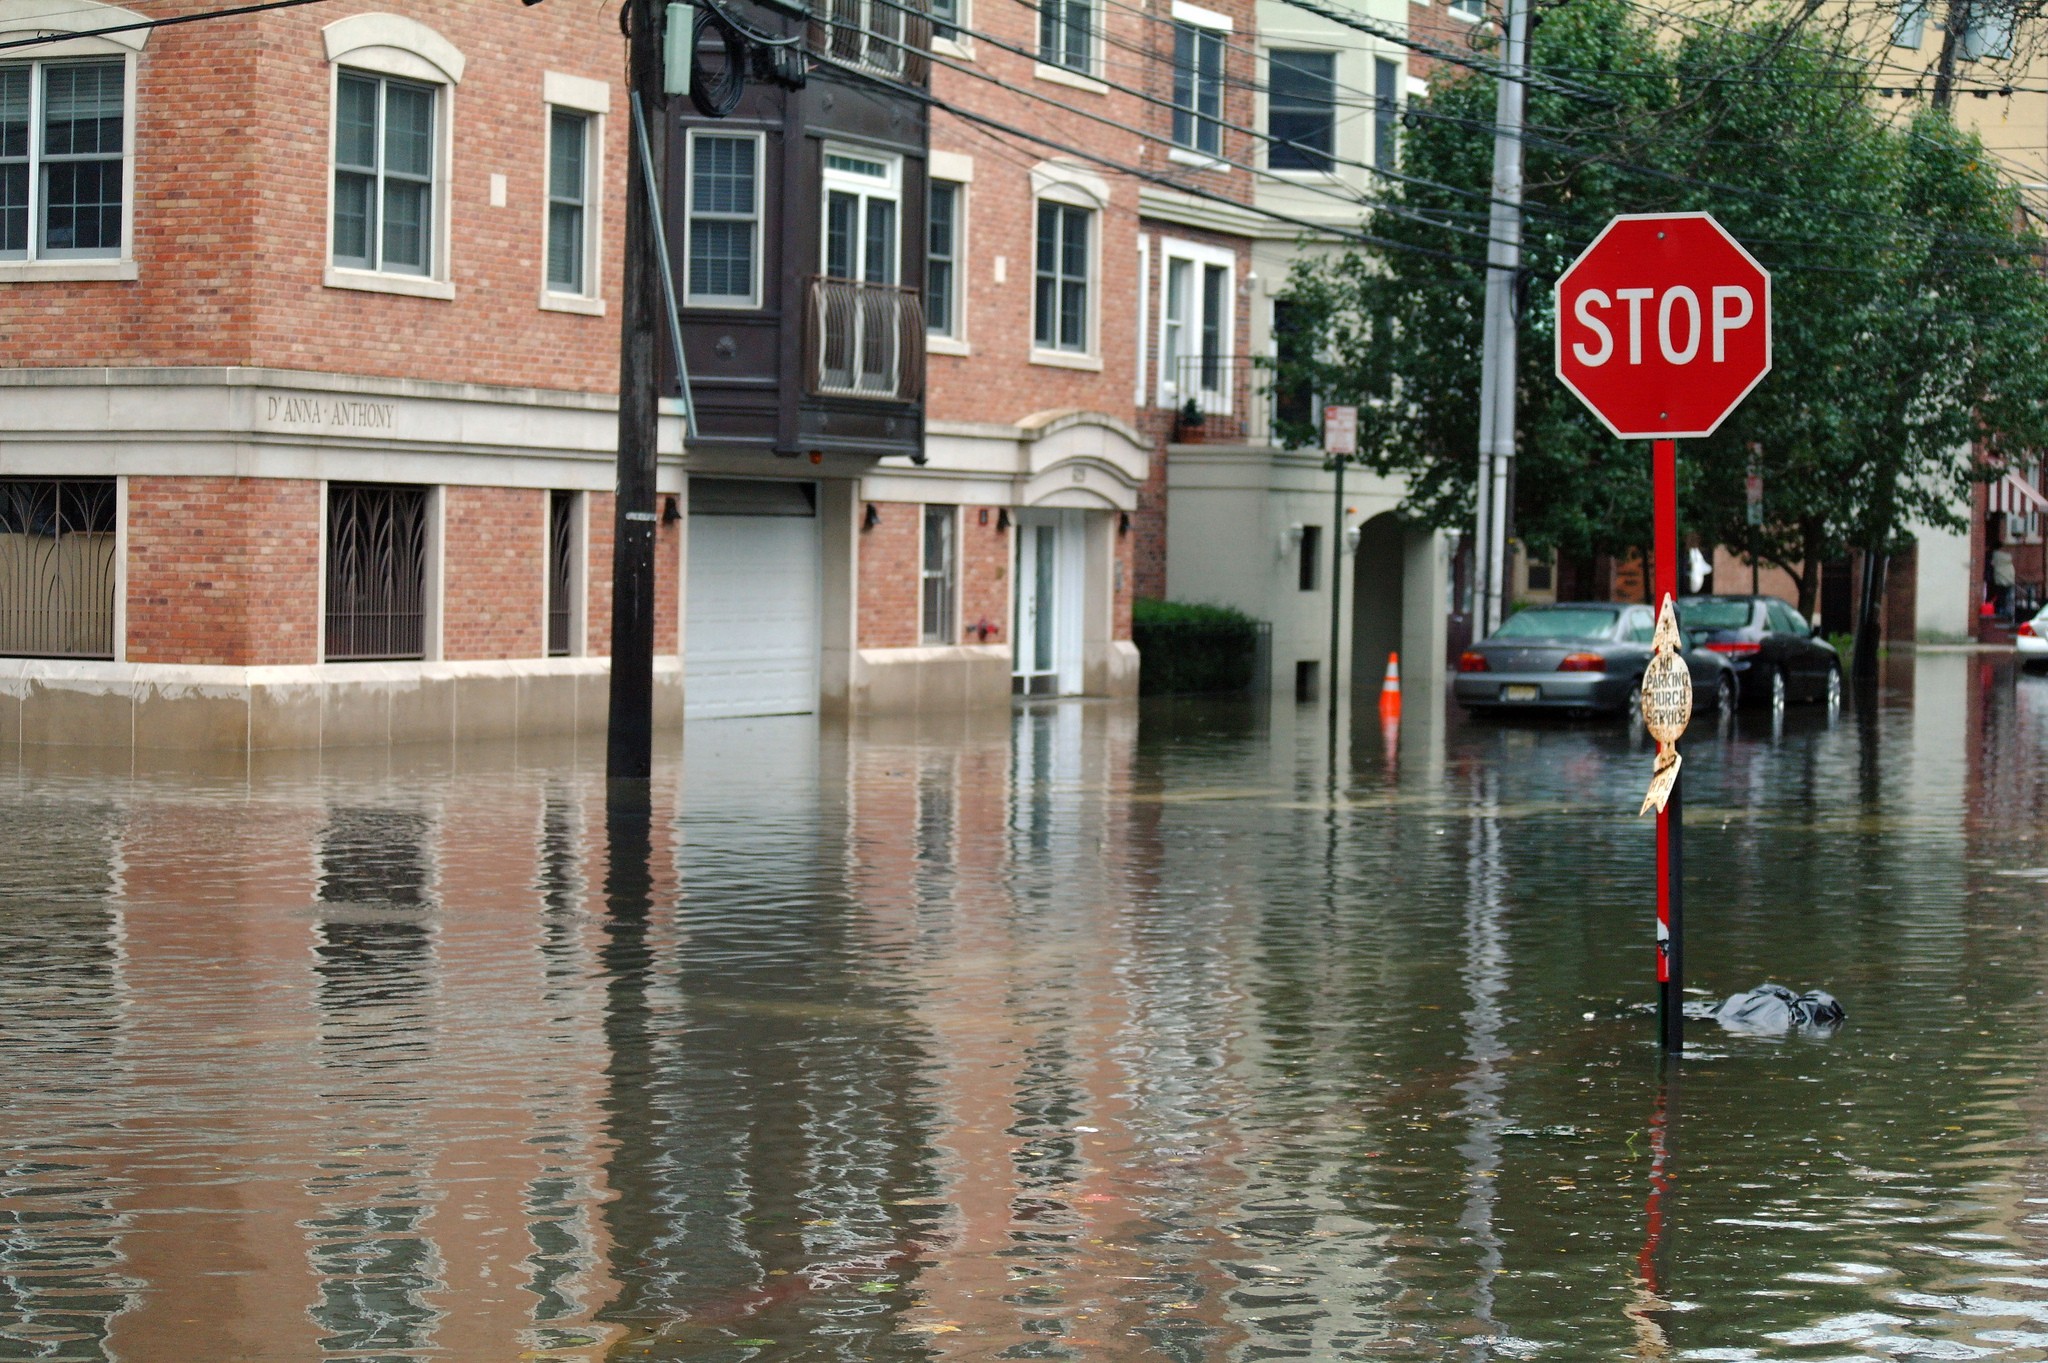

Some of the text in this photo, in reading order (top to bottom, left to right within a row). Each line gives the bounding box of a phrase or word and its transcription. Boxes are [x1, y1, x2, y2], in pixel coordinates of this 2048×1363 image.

[1572, 285, 1754, 368] STOP
[331, 402, 394, 429] ANTHONY
[1659, 657, 1673, 671] NO
[1646, 672, 1689, 689] PARKING
[1646, 690, 1687, 707] CHURCH
[1646, 709, 1686, 726] SERVICE
